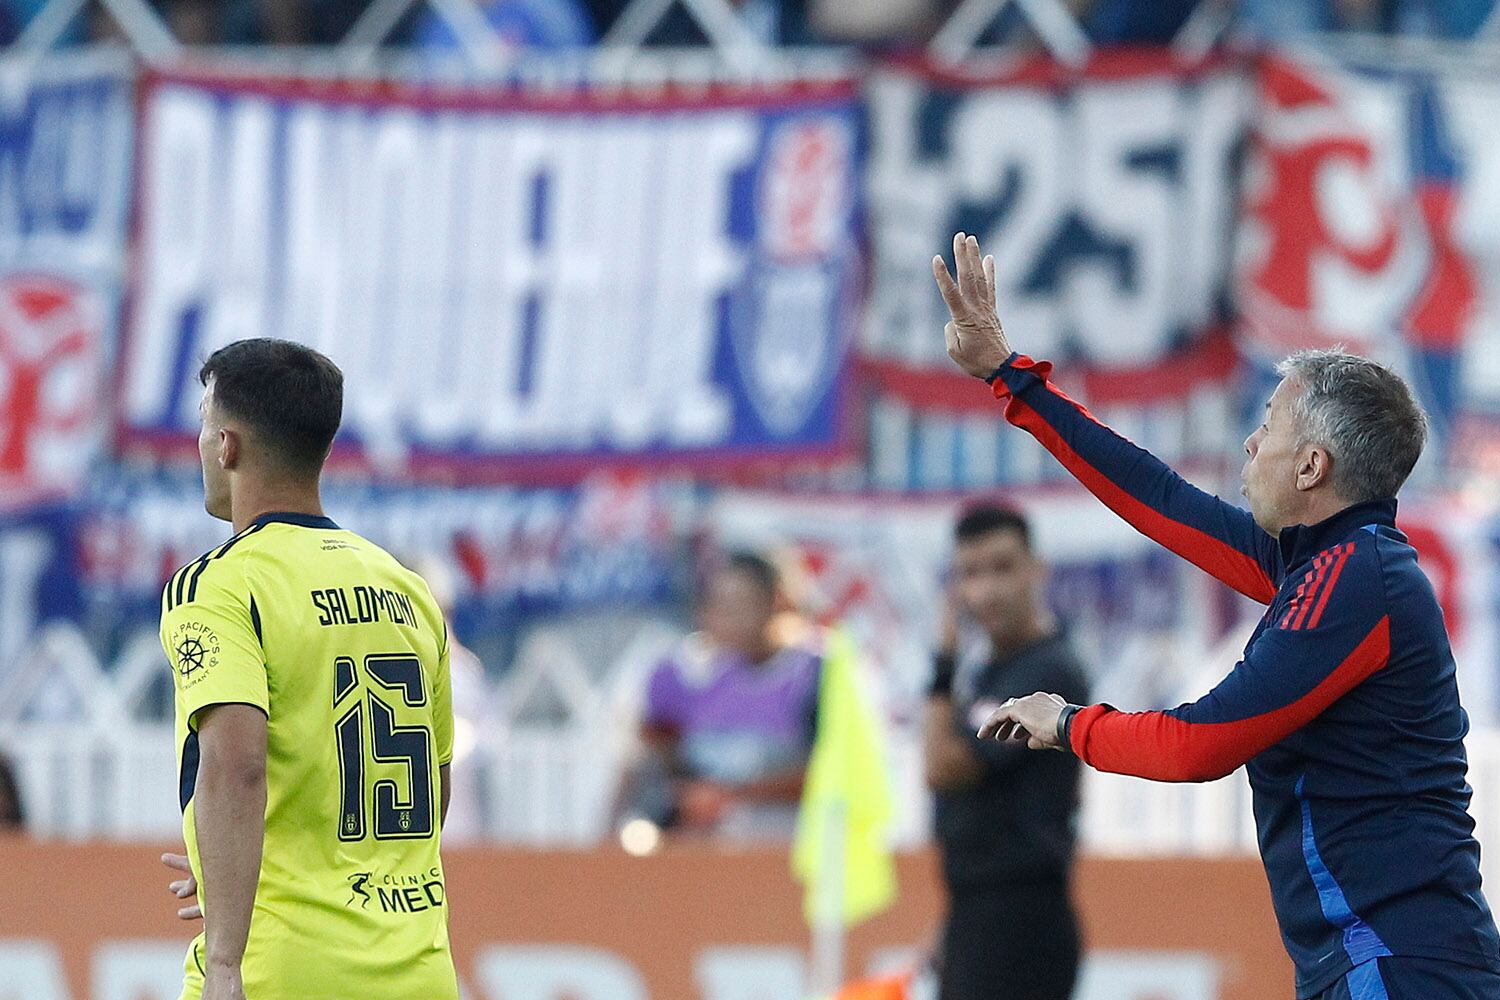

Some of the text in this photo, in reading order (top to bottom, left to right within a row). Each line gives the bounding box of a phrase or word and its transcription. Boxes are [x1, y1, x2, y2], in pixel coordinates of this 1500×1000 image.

[311, 586, 418, 630] SALOMONI
[179, 621, 220, 655] PACIFIC'S
[333, 655, 434, 842] 15
